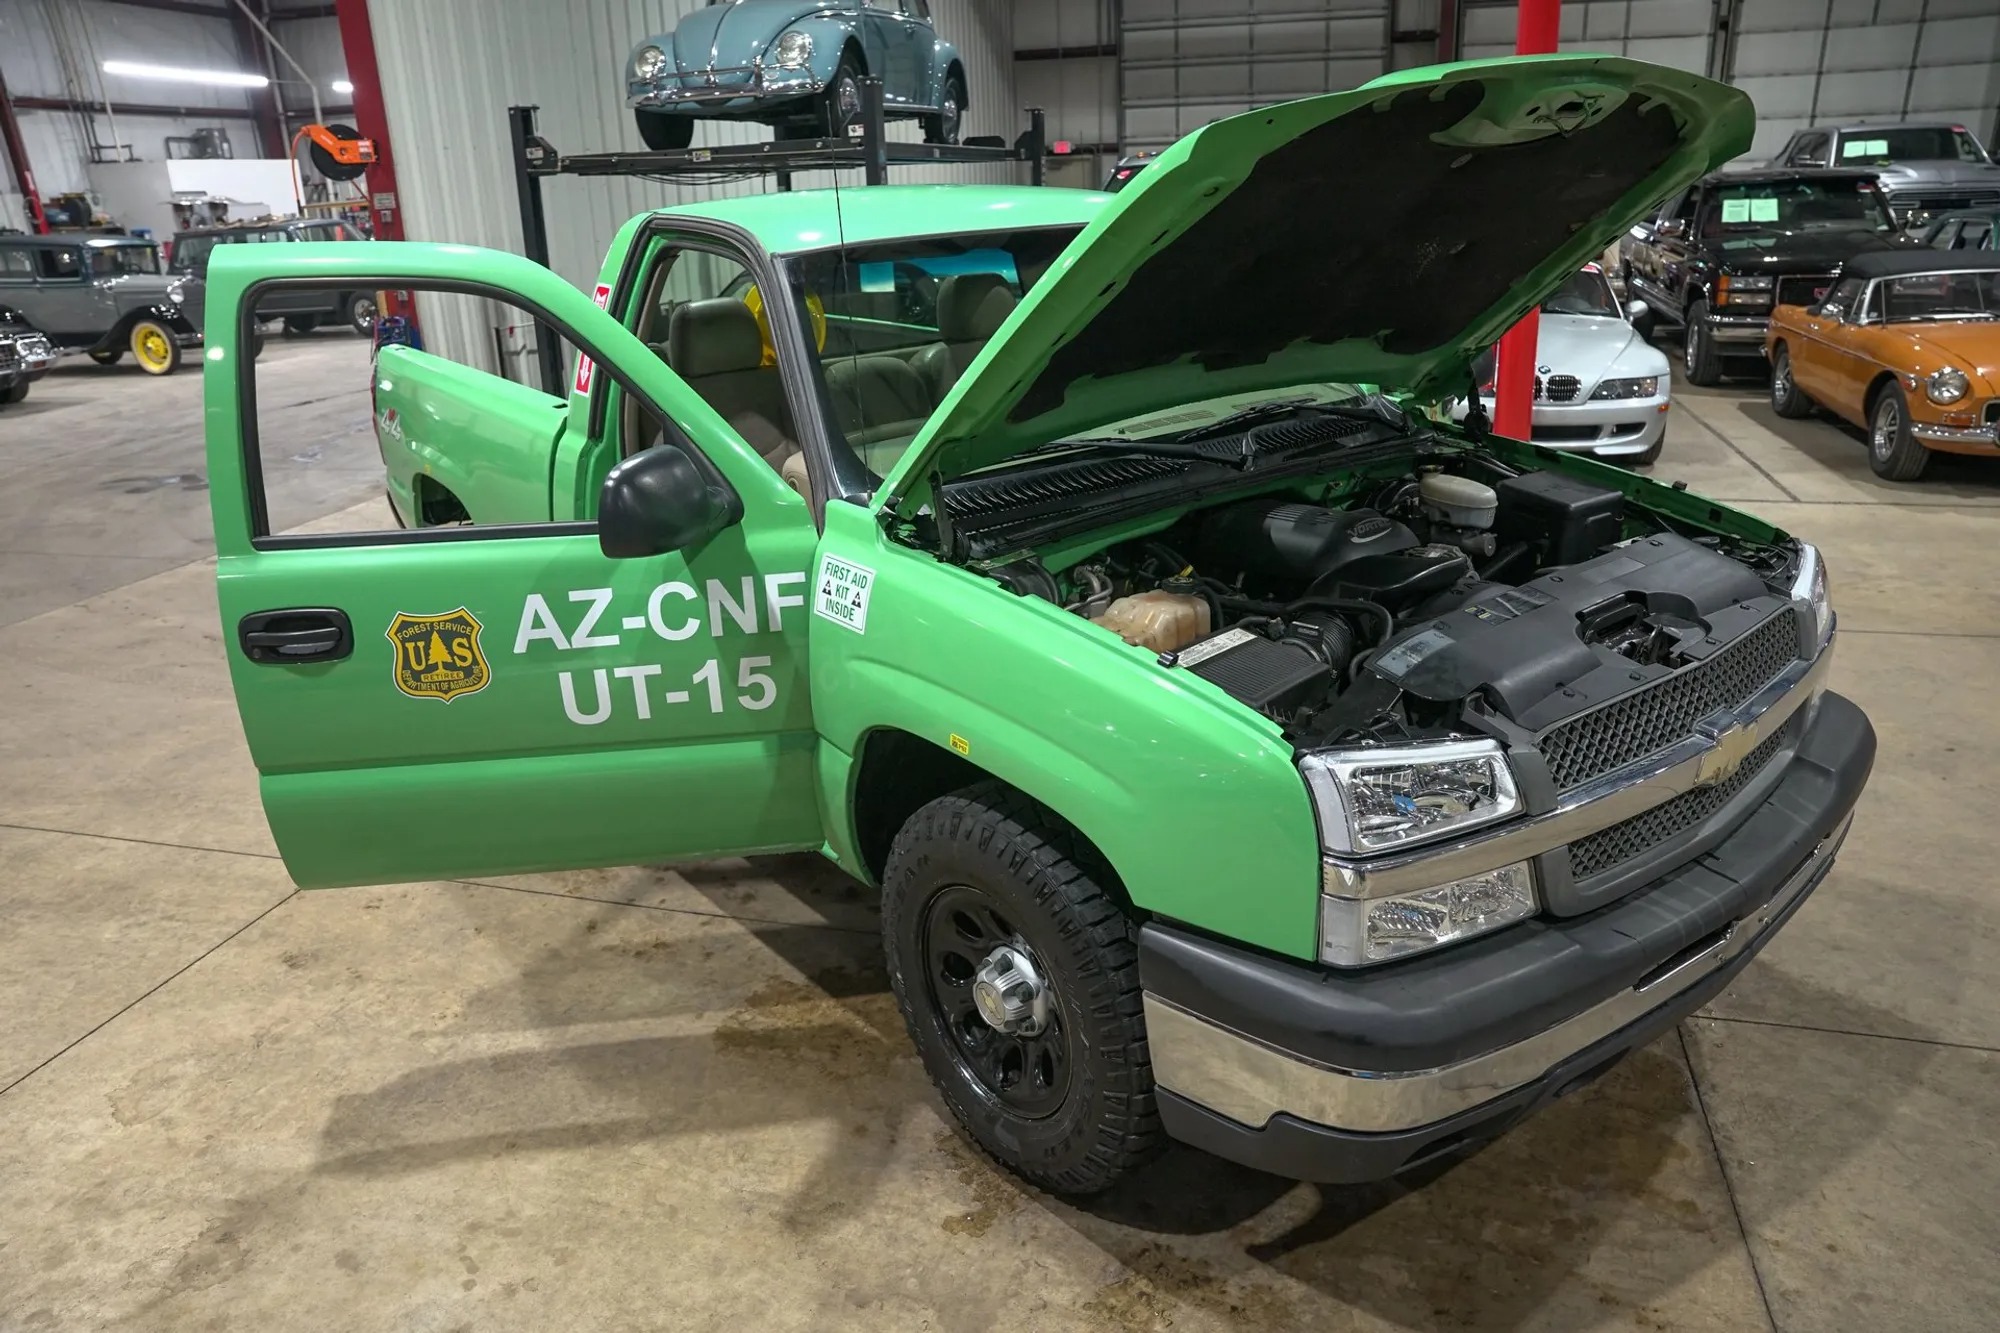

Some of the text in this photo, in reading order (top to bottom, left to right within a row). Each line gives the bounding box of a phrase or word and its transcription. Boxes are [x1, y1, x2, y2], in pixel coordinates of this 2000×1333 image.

[825, 562, 868, 589] FIRST AID
[835, 584, 850, 601] KIT
[513, 571, 806, 654] AZ-CNF
[825, 597, 855, 622] INSIDE
[396, 621, 472, 640] FOREST SERVICE
[402, 665, 482, 691] DEPARTMENT OF AGRICULTURE
[558, 656, 777, 725] UT-15
